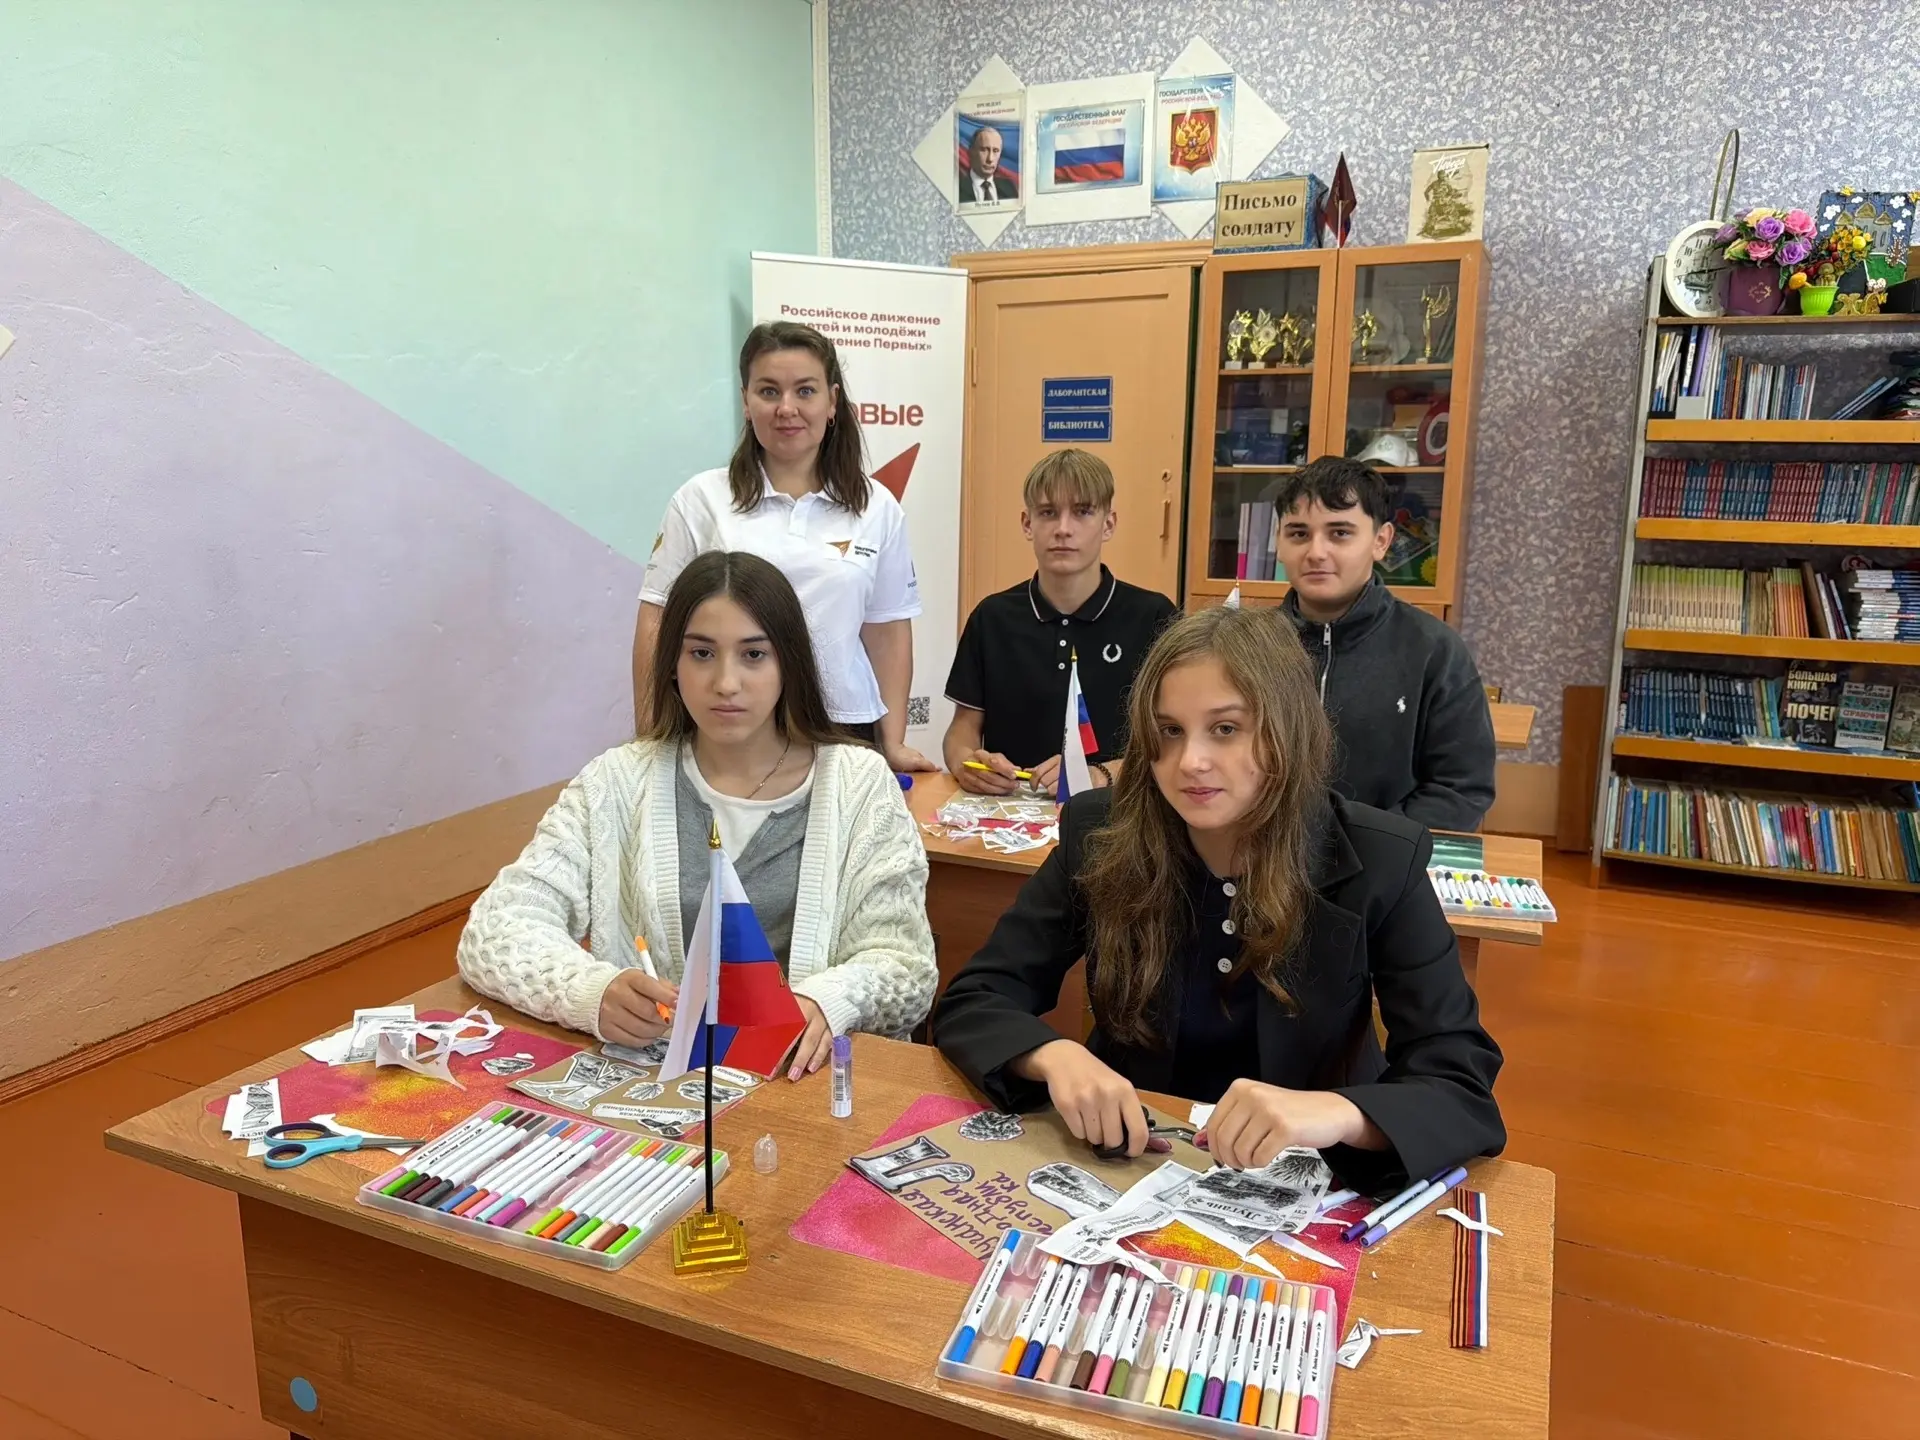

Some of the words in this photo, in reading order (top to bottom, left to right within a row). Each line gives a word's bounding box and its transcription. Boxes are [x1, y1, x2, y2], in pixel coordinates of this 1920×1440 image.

[1223, 193, 1297, 211] Письмо
[1221, 218, 1296, 238] солдату
[780, 304, 868, 321] Российское
[870, 312, 941, 326] движение
[842, 324, 851, 333] и
[854, 325, 926, 338] молодёжи
[874, 337, 933, 351] Первых»
[1047, 388, 1107, 397] ЛАБОРАНТСКАЯ
[1048, 420, 1104, 430] БИБЛИОТЕКА
[1788, 670, 1837, 683] БОЛЬШАЯ
[1787, 680, 1818, 691] КНИГА
[1205, 1200, 1261, 1221] Лугань
